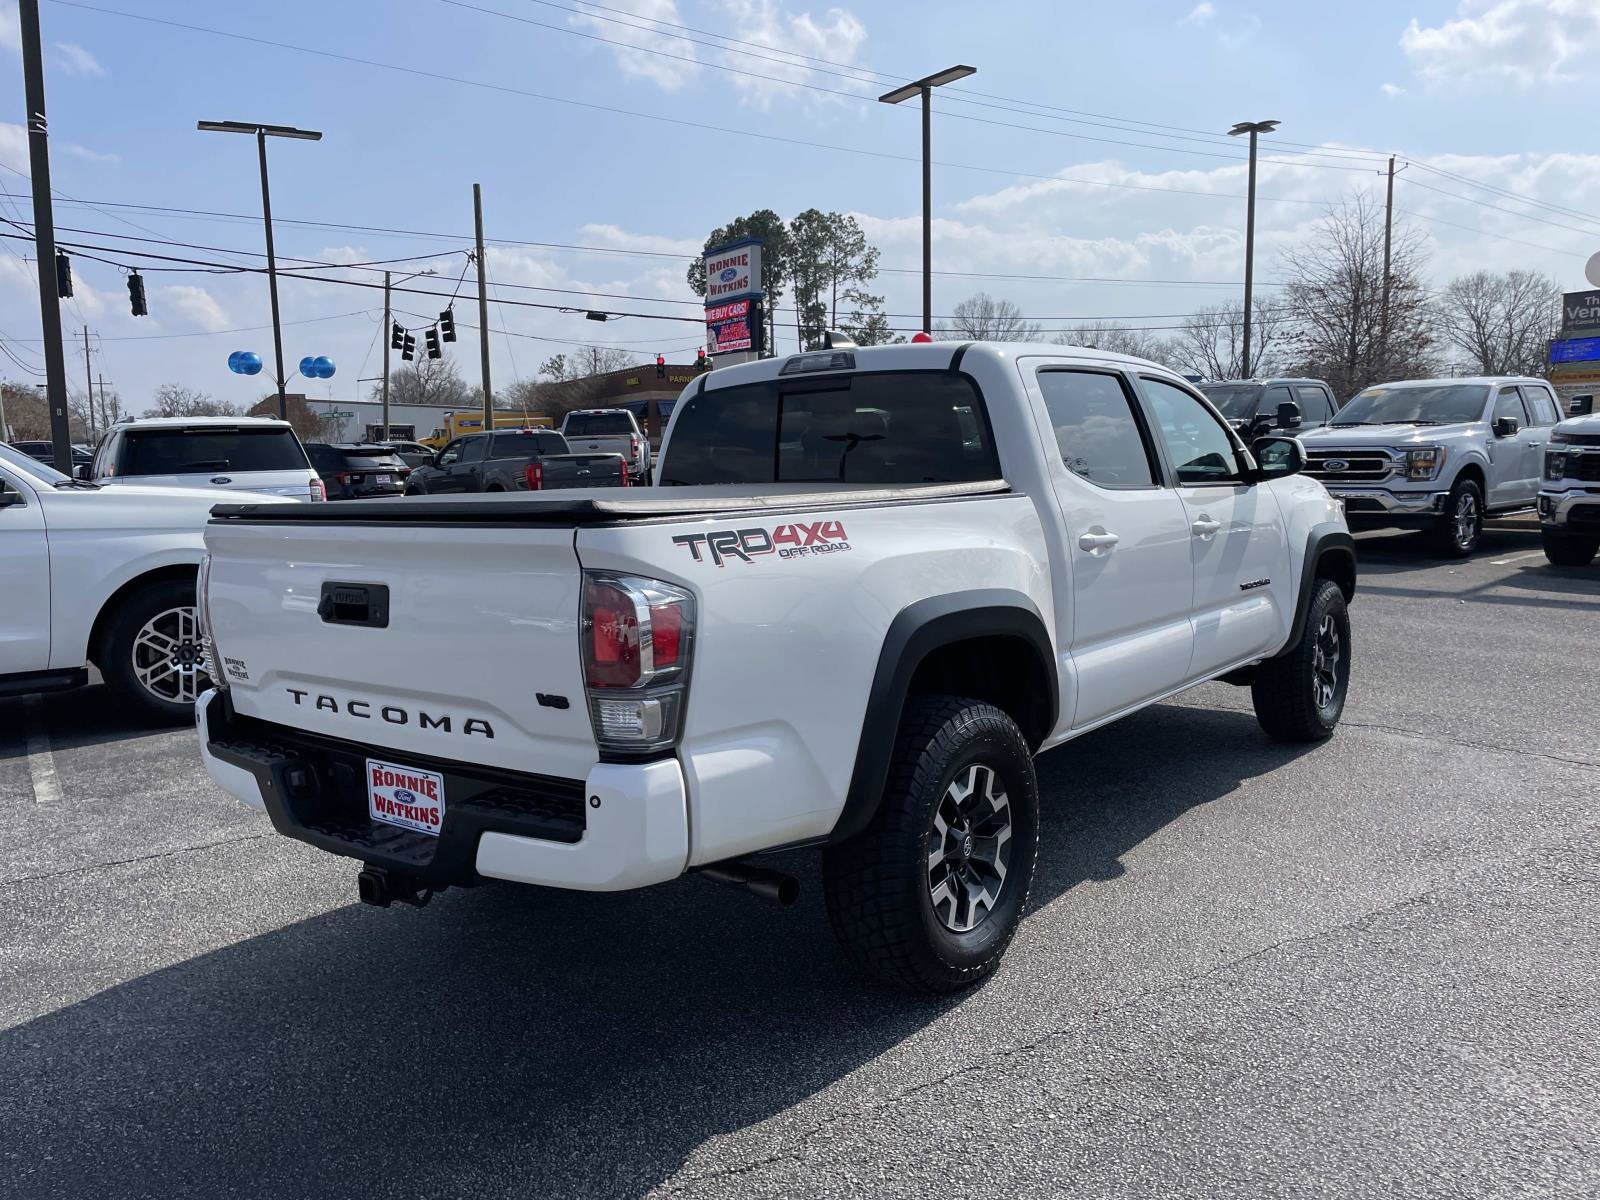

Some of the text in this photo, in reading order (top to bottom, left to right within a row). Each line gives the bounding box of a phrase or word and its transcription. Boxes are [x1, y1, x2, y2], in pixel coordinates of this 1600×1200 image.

[709, 254, 749, 276] RONNIE
[710, 275, 749, 295] WATKINS
[716, 305, 728, 318] BUY
[671, 527, 776, 568] TRD
[778, 542, 852, 560] OFF ROAD
[285, 688, 496, 739] TACOMA
[372, 768, 439, 802] RONNIE
[373, 792, 441, 826] WATKINS
